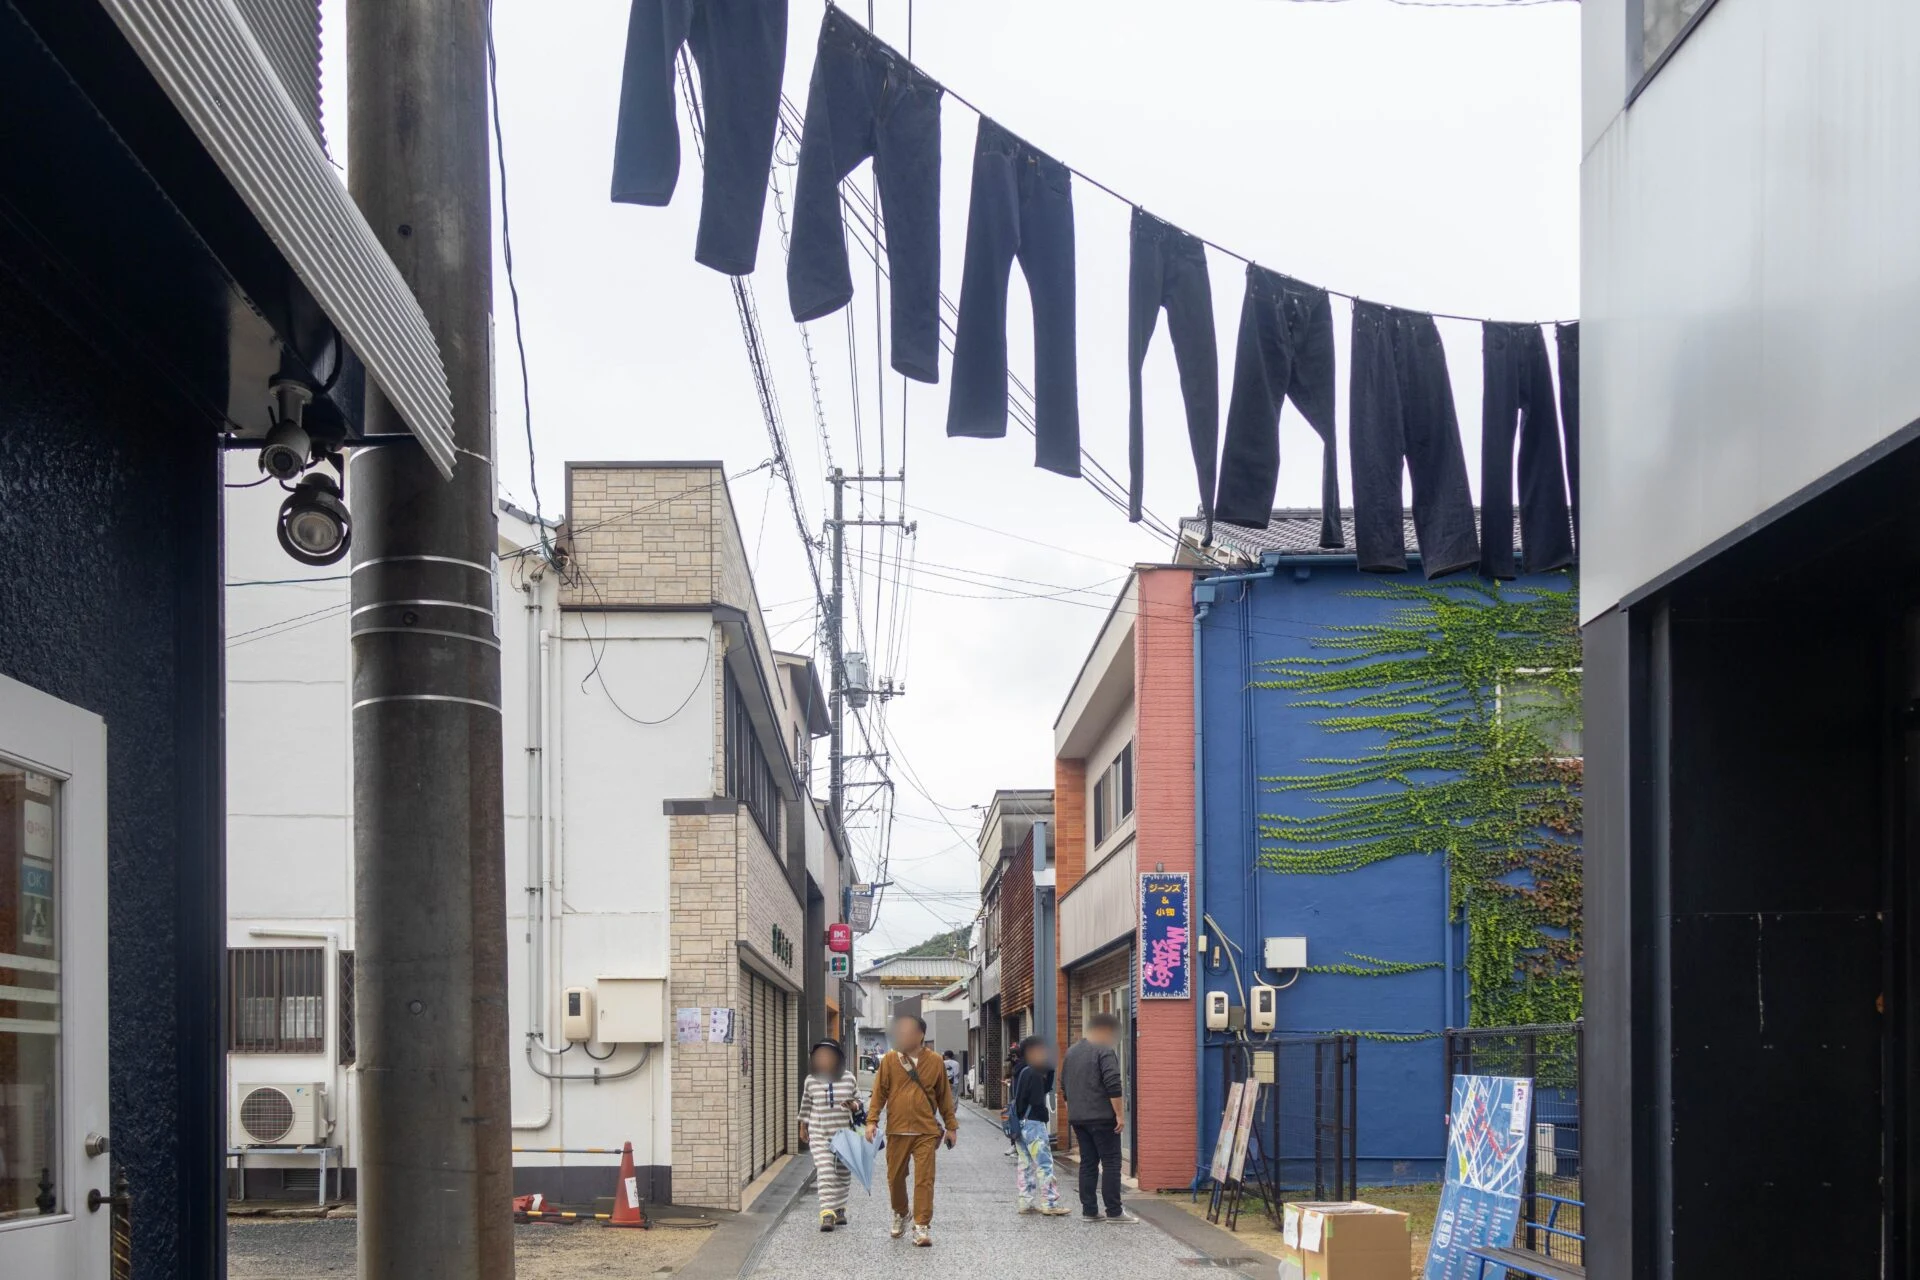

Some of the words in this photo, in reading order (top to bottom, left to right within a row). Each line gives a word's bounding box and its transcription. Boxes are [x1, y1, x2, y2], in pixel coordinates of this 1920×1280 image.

[1149, 884, 1181, 892] ジーンズ
[1161, 896, 1169, 904] &
[1156, 908, 1175, 917] 小物
